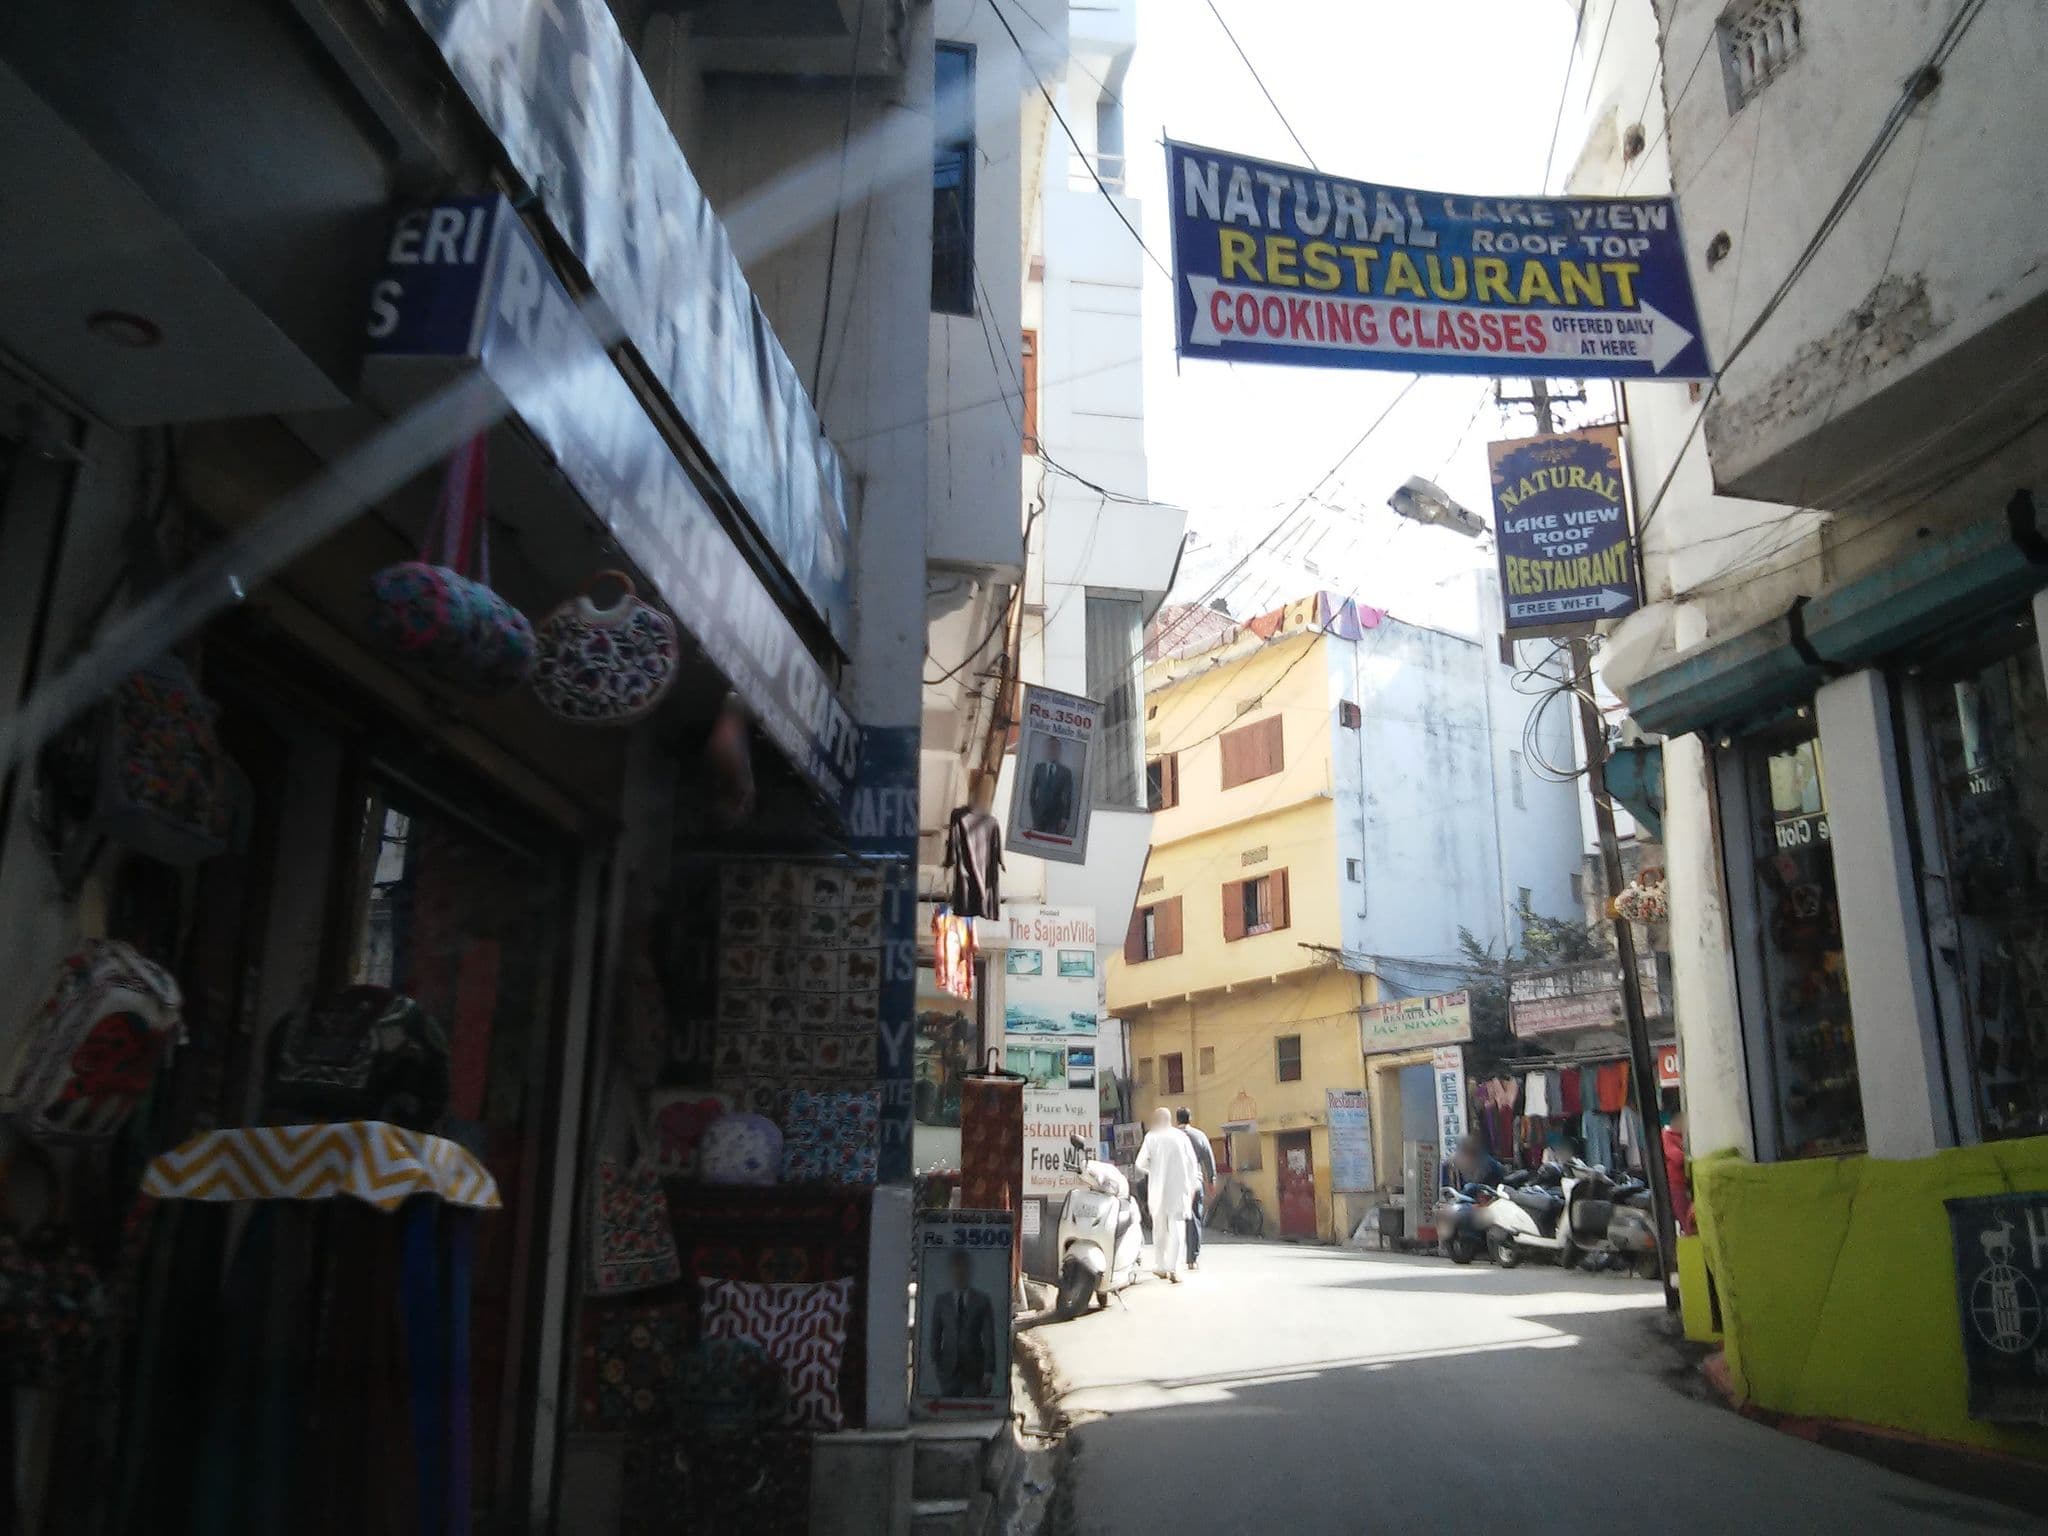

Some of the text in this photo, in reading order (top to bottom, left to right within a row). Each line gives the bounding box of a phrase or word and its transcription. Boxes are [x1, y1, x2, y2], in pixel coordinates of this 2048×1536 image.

[1183, 156, 1668, 249] NATURAL LAKE VIEW
[1471, 228, 1651, 259] ROOF TOP
[1218, 227, 1640, 309] RESTAURANT
[1209, 290, 1656, 355] COOKING CLASSES OFFERED DAILY
[1580, 339, 1638, 358] AT HERE
[1498, 466, 1620, 514] NATURAL
[1504, 506, 1620, 534] LAKE VIEW
[1532, 526, 1595, 545] ROOF
[1542, 542, 1589, 558] TOP
[1505, 540, 1629, 596] RESTAURANT
[1517, 596, 1600, 616] FREE WI-FI
[788, 648, 859, 779] CRAFTS
[1009, 917, 1031, 940] The
[1036, 1104, 1087, 1116] Pure Veg.
[1024, 1121, 1094, 1138] estaurant
[1031, 1147, 1060, 1170] Free
